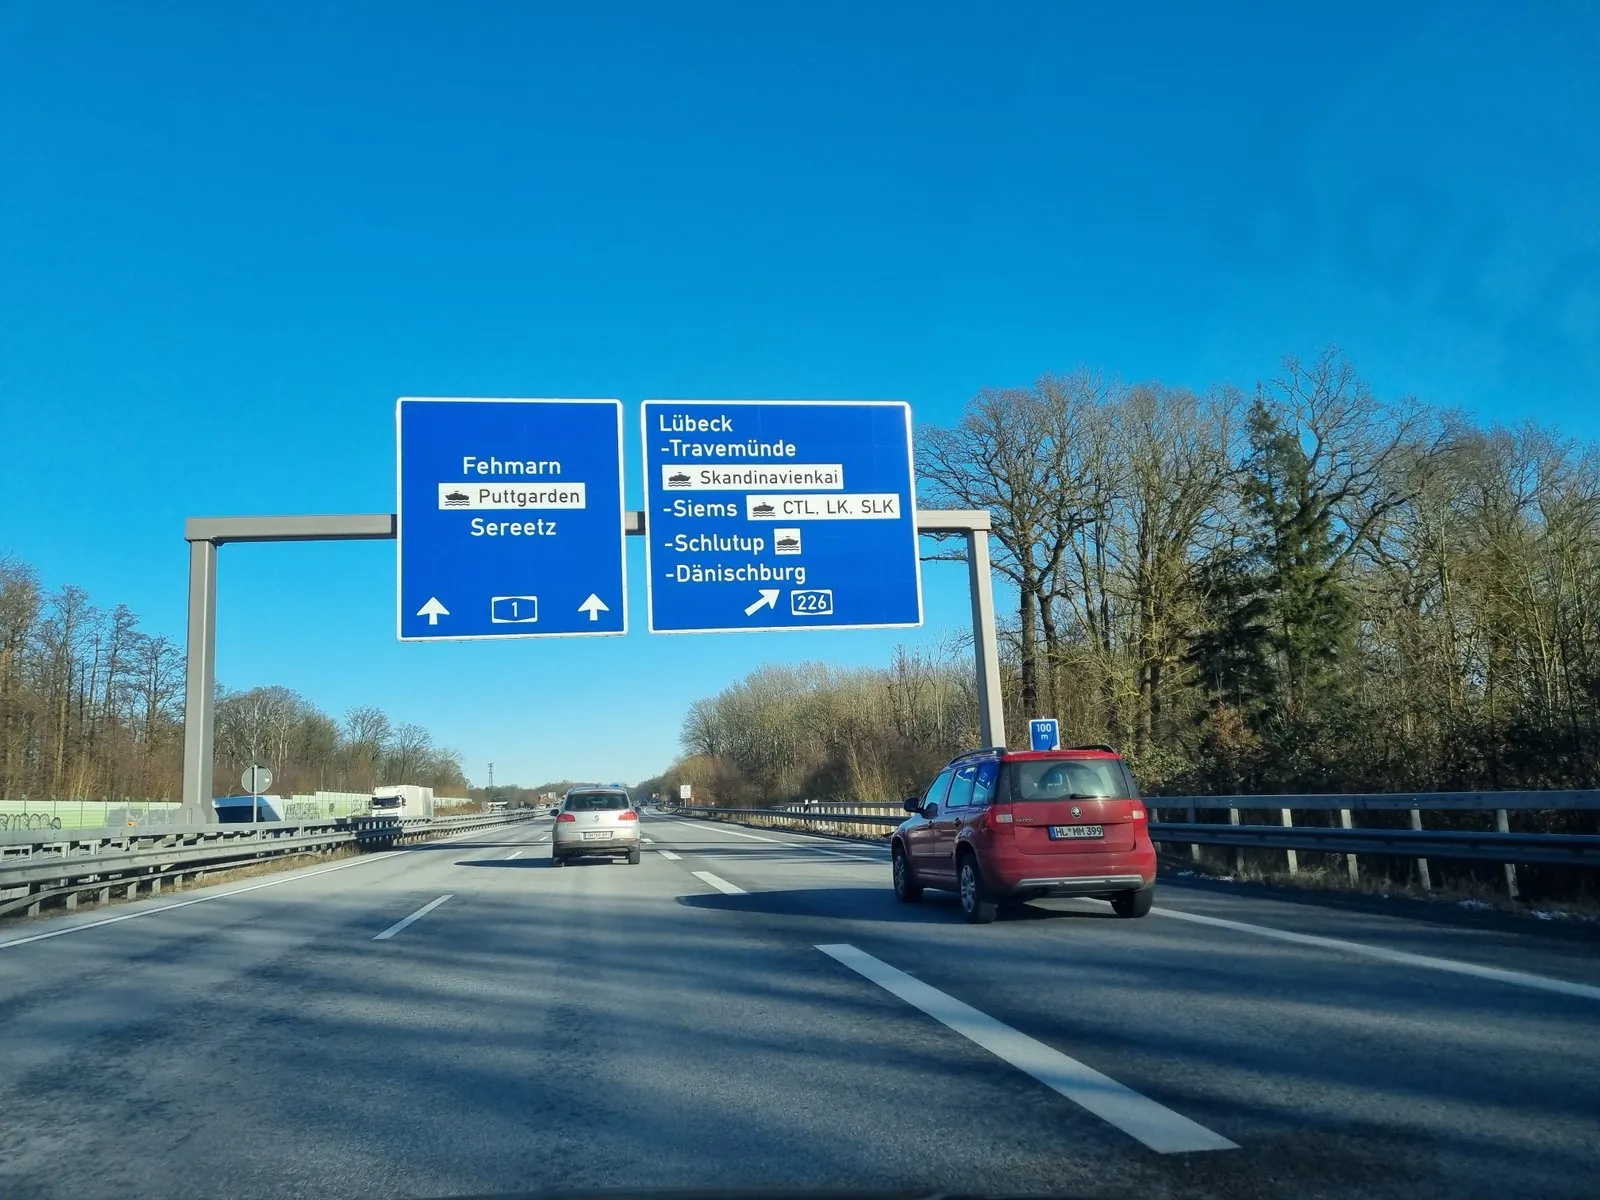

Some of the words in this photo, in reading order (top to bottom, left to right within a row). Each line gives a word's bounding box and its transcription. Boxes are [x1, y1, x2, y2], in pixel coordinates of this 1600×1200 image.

[659, 414, 734, 432] Lübeck
[462, 456, 562, 475] Fehmarn
[700, 469, 838, 485] Skandinavienkai
[479, 488, 580, 507] Puttgarden
[861, 499, 894, 514] SLK
[470, 518, 557, 536] Sereetz
[511, 602, 518, 617] 1
[797, 595, 827, 610] 226
[1036, 723, 1052, 733] 100
[1087, 826, 1102, 836] 399
